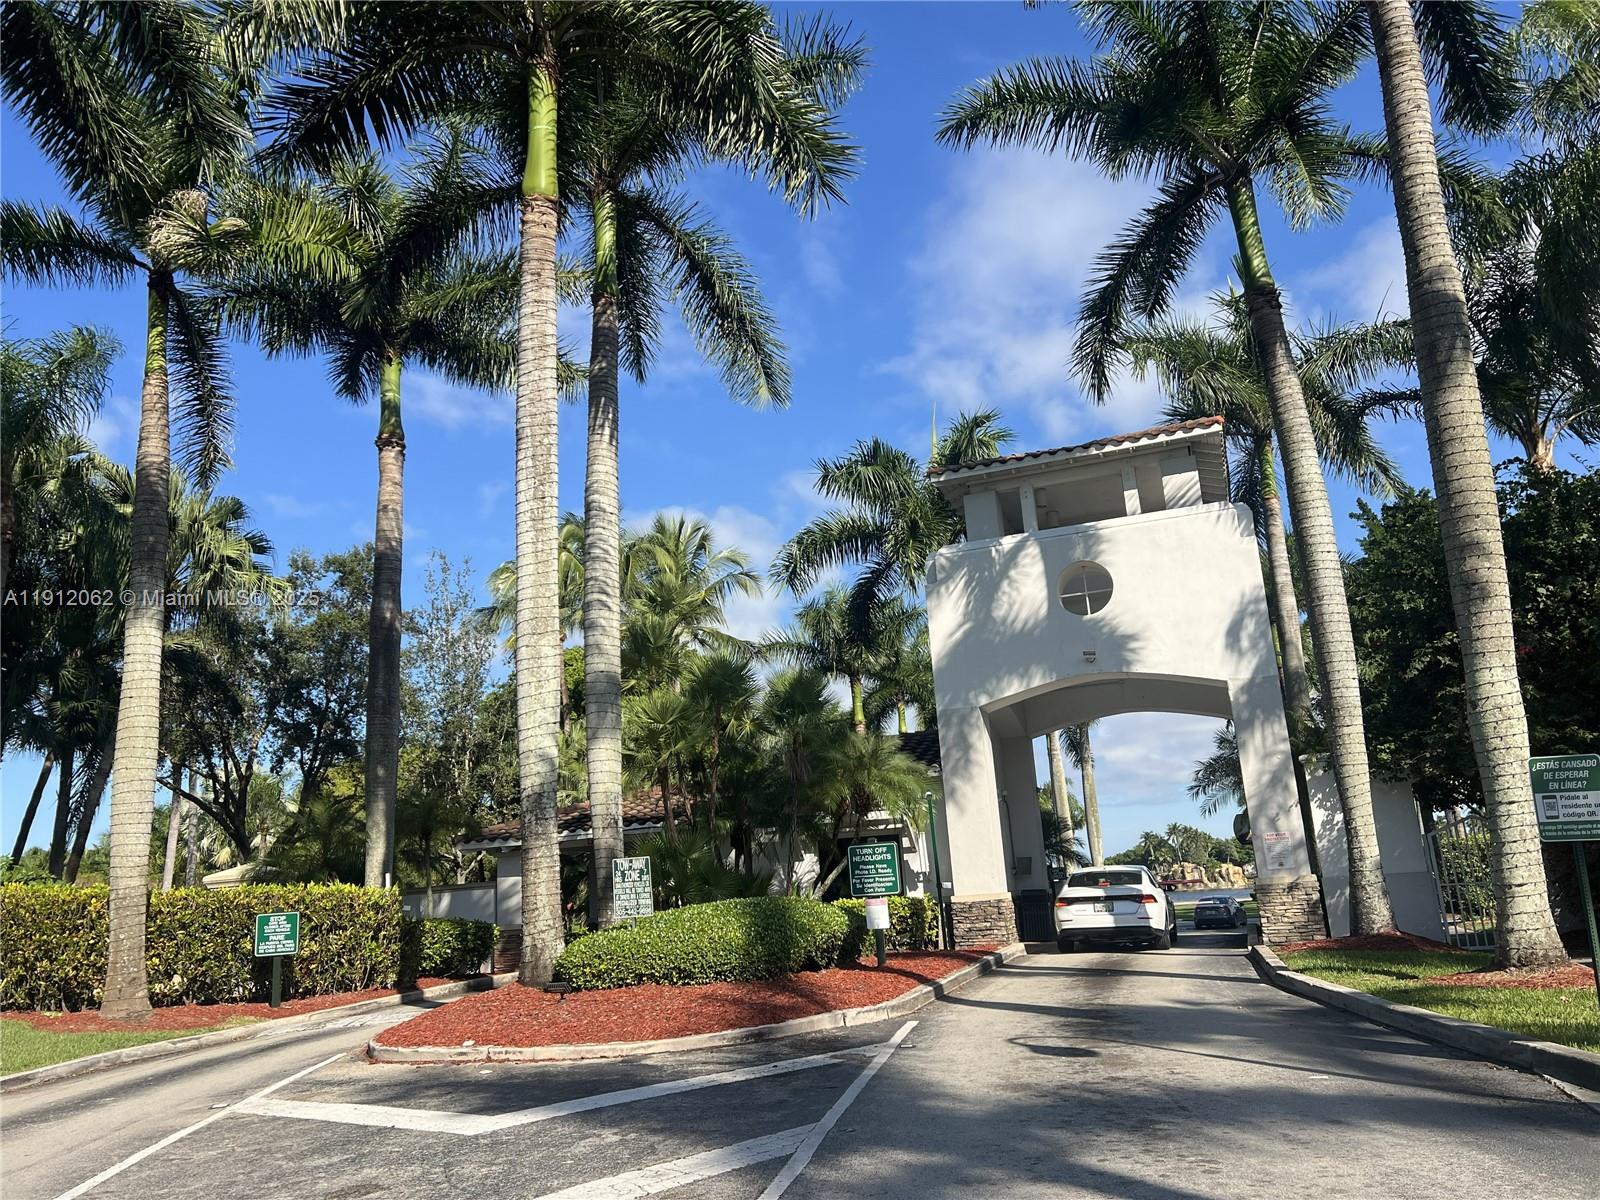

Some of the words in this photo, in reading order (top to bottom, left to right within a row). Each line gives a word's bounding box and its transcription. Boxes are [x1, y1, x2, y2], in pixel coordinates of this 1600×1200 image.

[1532, 760, 1560, 772] ¿ESTÁS
[1561, 759, 1597, 768] CANSADO
[1543, 772, 1554, 780] DE
[1555, 770, 1590, 779] ESPERAR
[1549, 781, 1559, 790] EN
[1560, 779, 1587, 790] LÍNEA?
[616, 859, 645, 870] TOW-AWAY
[624, 870, 640, 881] ZONE
